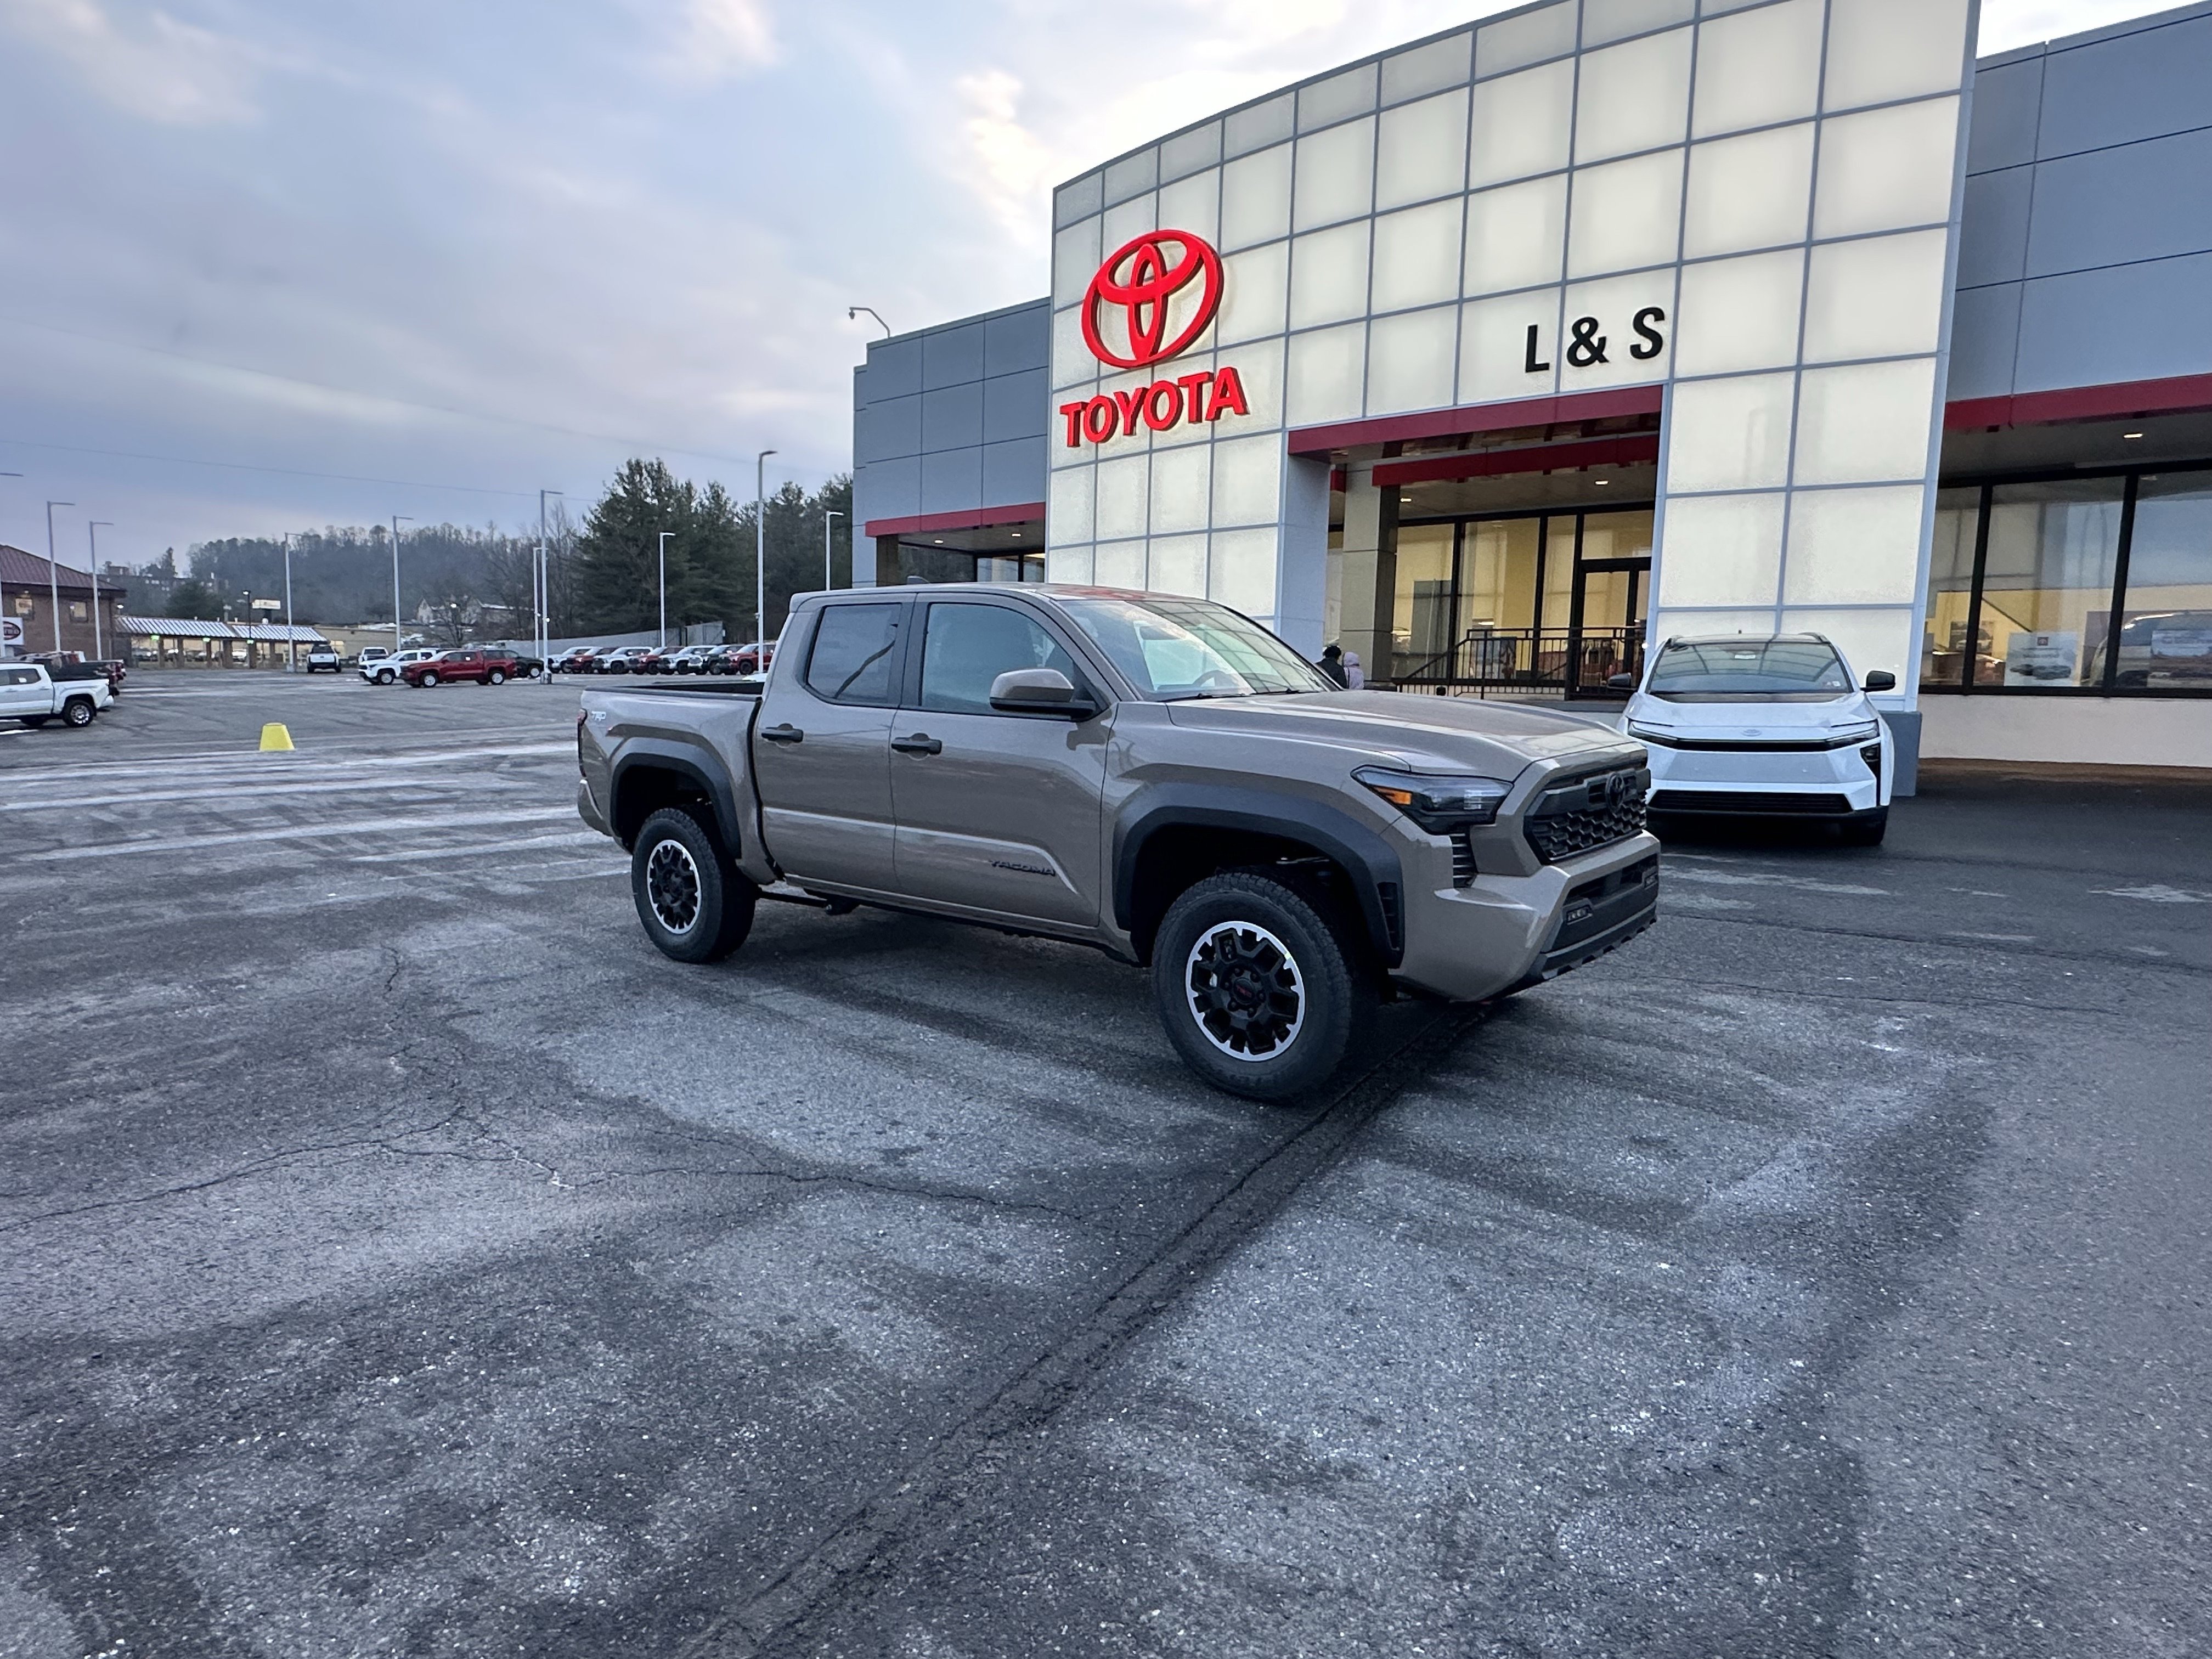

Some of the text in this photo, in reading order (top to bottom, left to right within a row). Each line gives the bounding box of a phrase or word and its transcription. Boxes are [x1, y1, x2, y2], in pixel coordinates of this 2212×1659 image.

[1525, 307, 1665, 373] L & S
[1060, 367, 1250, 447] TOYOTA
[989, 860, 1056, 877] TACOMA
